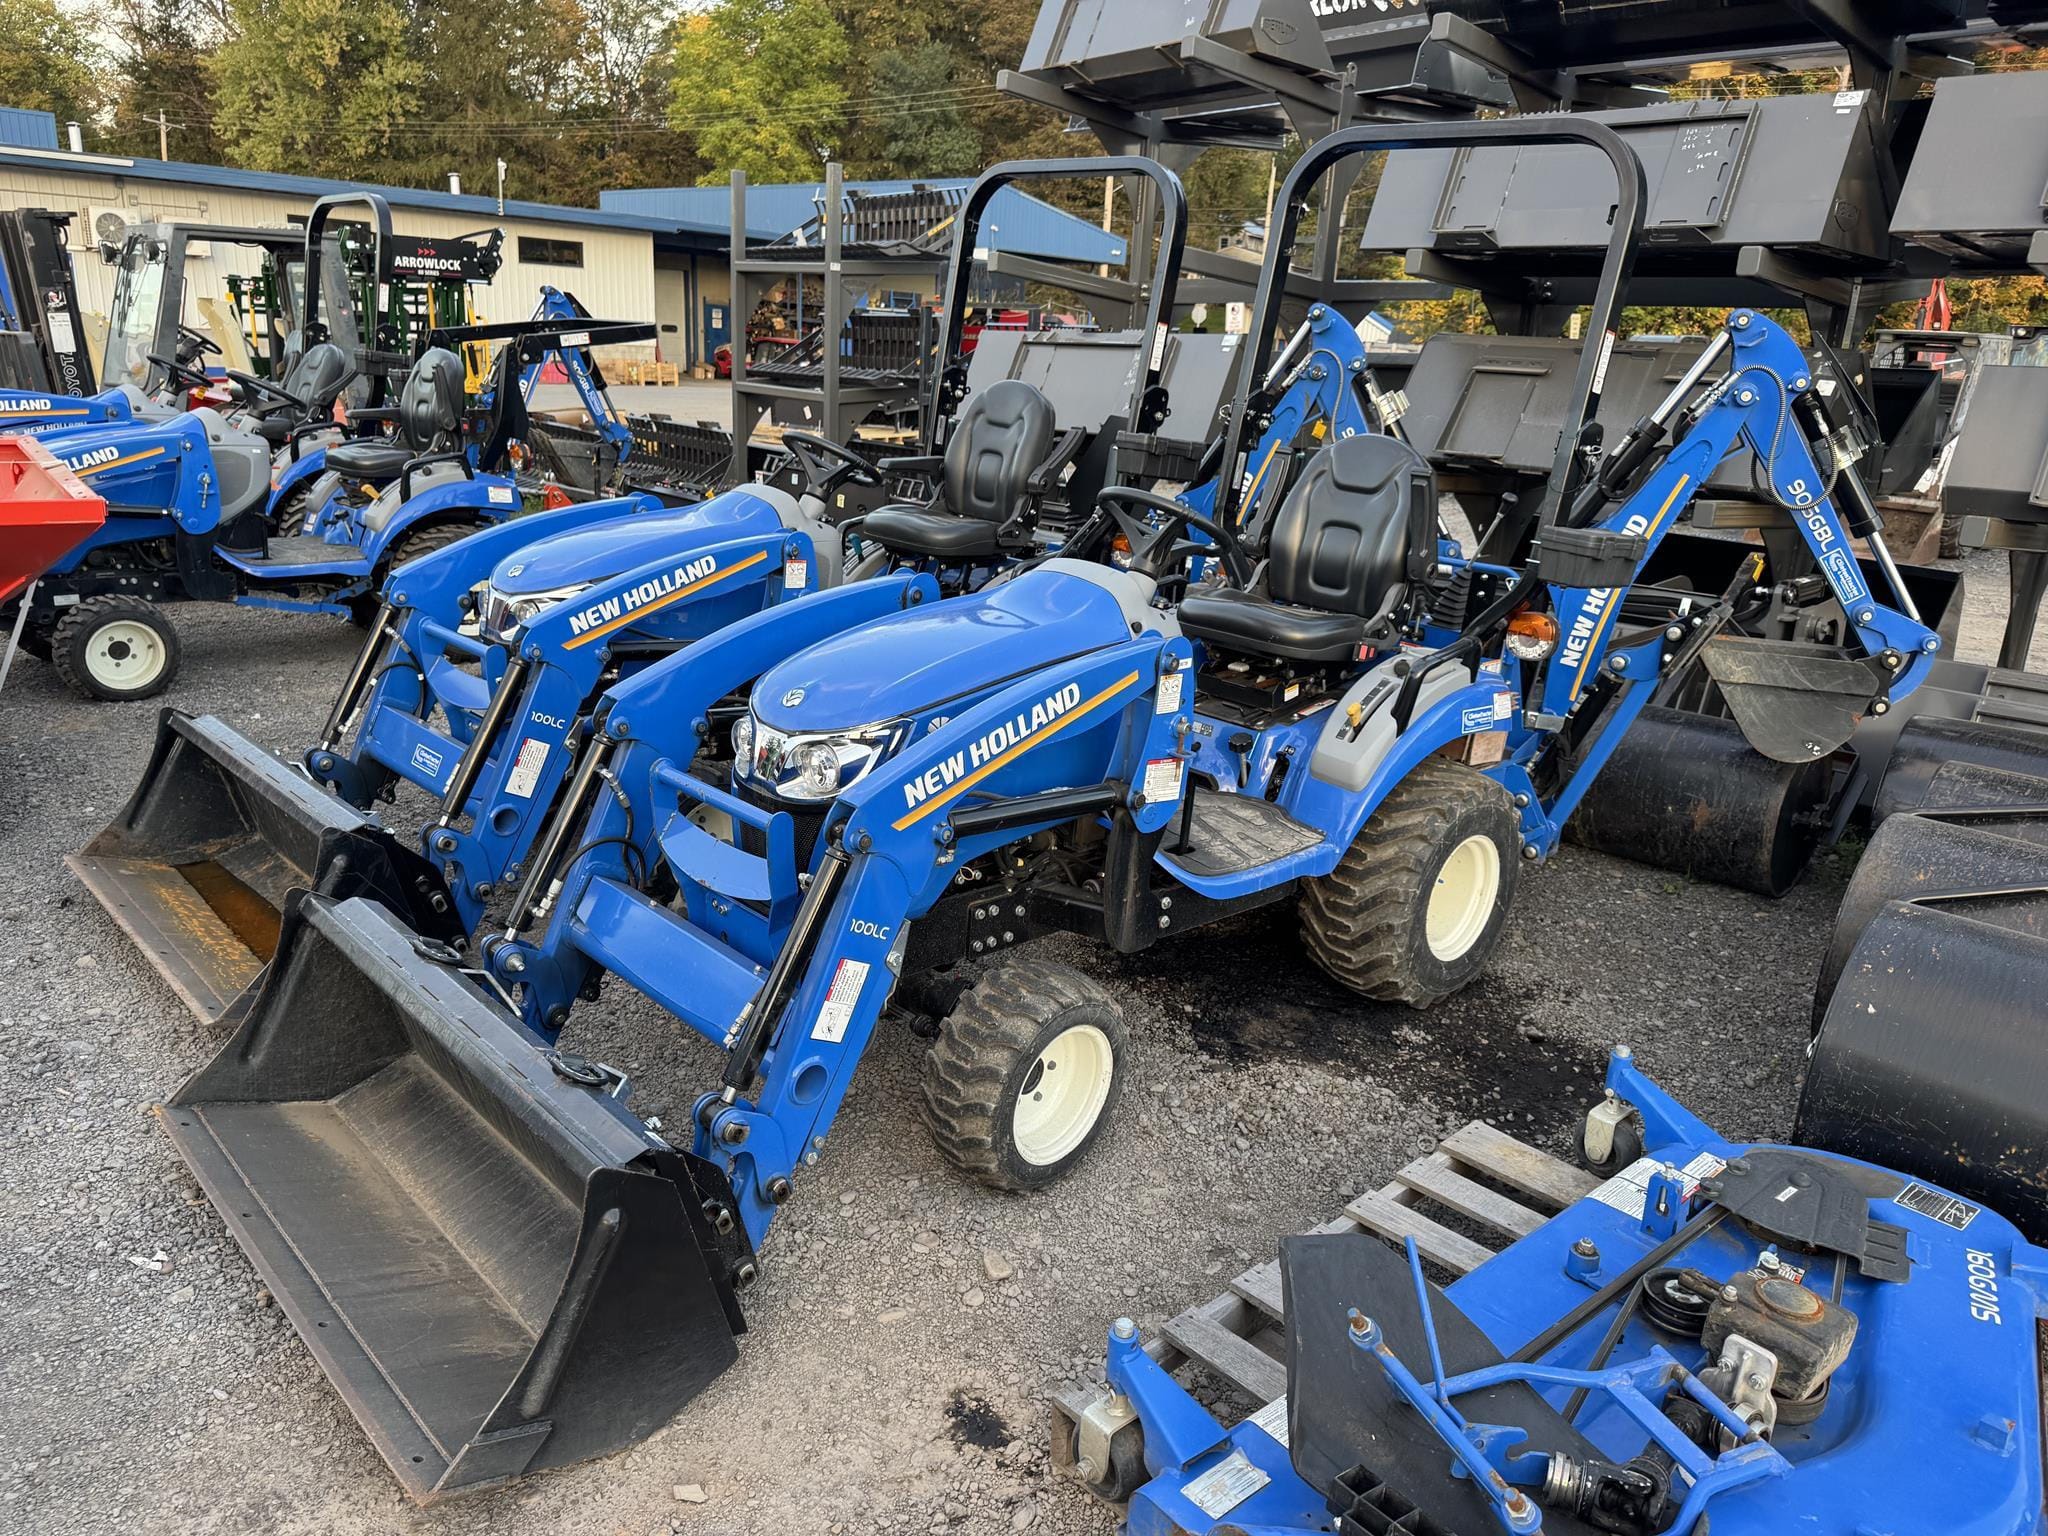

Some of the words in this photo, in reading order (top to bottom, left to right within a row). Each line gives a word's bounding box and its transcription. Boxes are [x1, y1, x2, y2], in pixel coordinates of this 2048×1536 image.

[394, 255, 461, 271] ARROWLOCK
[60, 350, 82, 397] OYOT
[62, 446, 120, 472] LLAND
[1787, 479, 1835, 552] 905GBL
[569, 597, 621, 635] NEW
[622, 554, 717, 611] HOLLAND
[1559, 615, 1595, 667] NEW
[530, 711, 566, 729] 100LC
[903, 750, 966, 808] NEW
[969, 682, 1081, 768] HOLLAND
[850, 918, 890, 940] 100LC
[1965, 1247, 2001, 1325] 160GMS
